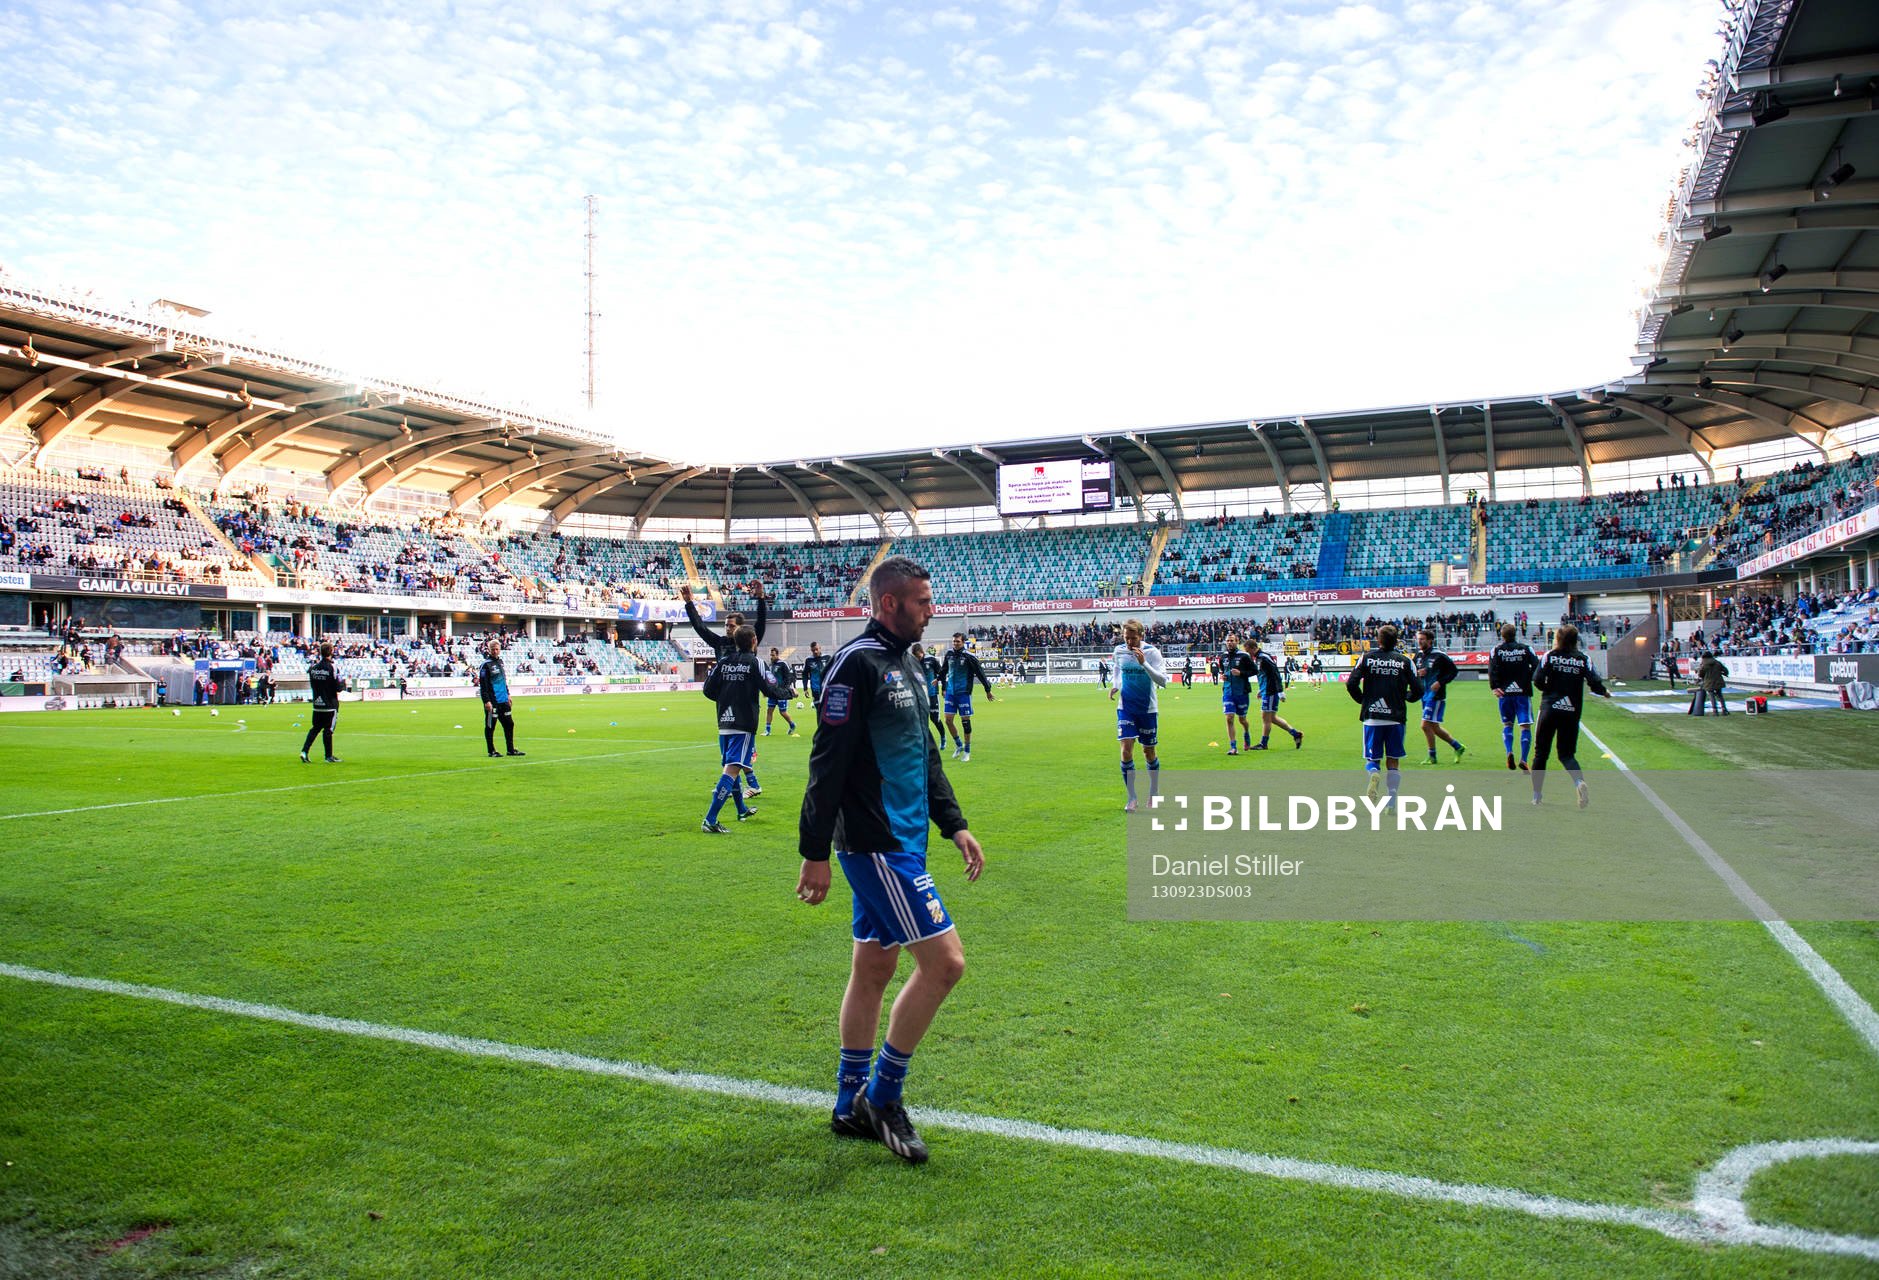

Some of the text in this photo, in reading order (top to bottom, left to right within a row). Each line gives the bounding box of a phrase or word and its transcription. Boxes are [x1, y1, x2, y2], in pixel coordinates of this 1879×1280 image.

[1776, 549, 1784, 563] GT
[1790, 541, 1800, 558] GT
[1806, 534, 1817, 551] GT
[1825, 526, 1837, 544] GT
[1846, 517, 1859, 536] GT
[78, 578, 191, 596] GAMLA ULLEVI
[1461, 584, 1538, 596] Prioritet Finans
[1178, 594, 1245, 604] Prioritet Finans
[1268, 591, 1338, 602] Prioritet Finans
[1362, 588, 1436, 599] Prioritet Finans
[1012, 600, 1072, 610] Prioritet Finans
[1093, 597, 1156, 608] Prioritet Finans
[792, 608, 844, 619] Prioritet Finans
[935, 603, 992, 614] Prioritet Finans
[1498, 648, 1527, 658] Prioritet
[1367, 658, 1404, 670] Prioritet
[1550, 656, 1585, 668] Prioritet
[720, 663, 750, 674] Prioritet
[1370, 666, 1399, 676] Finans
[1552, 664, 1580, 674] Finans
[544, 676, 586, 686] INTERSPORT
[722, 672, 745, 680] Finans
[1552, 704, 1576, 712] adidas
